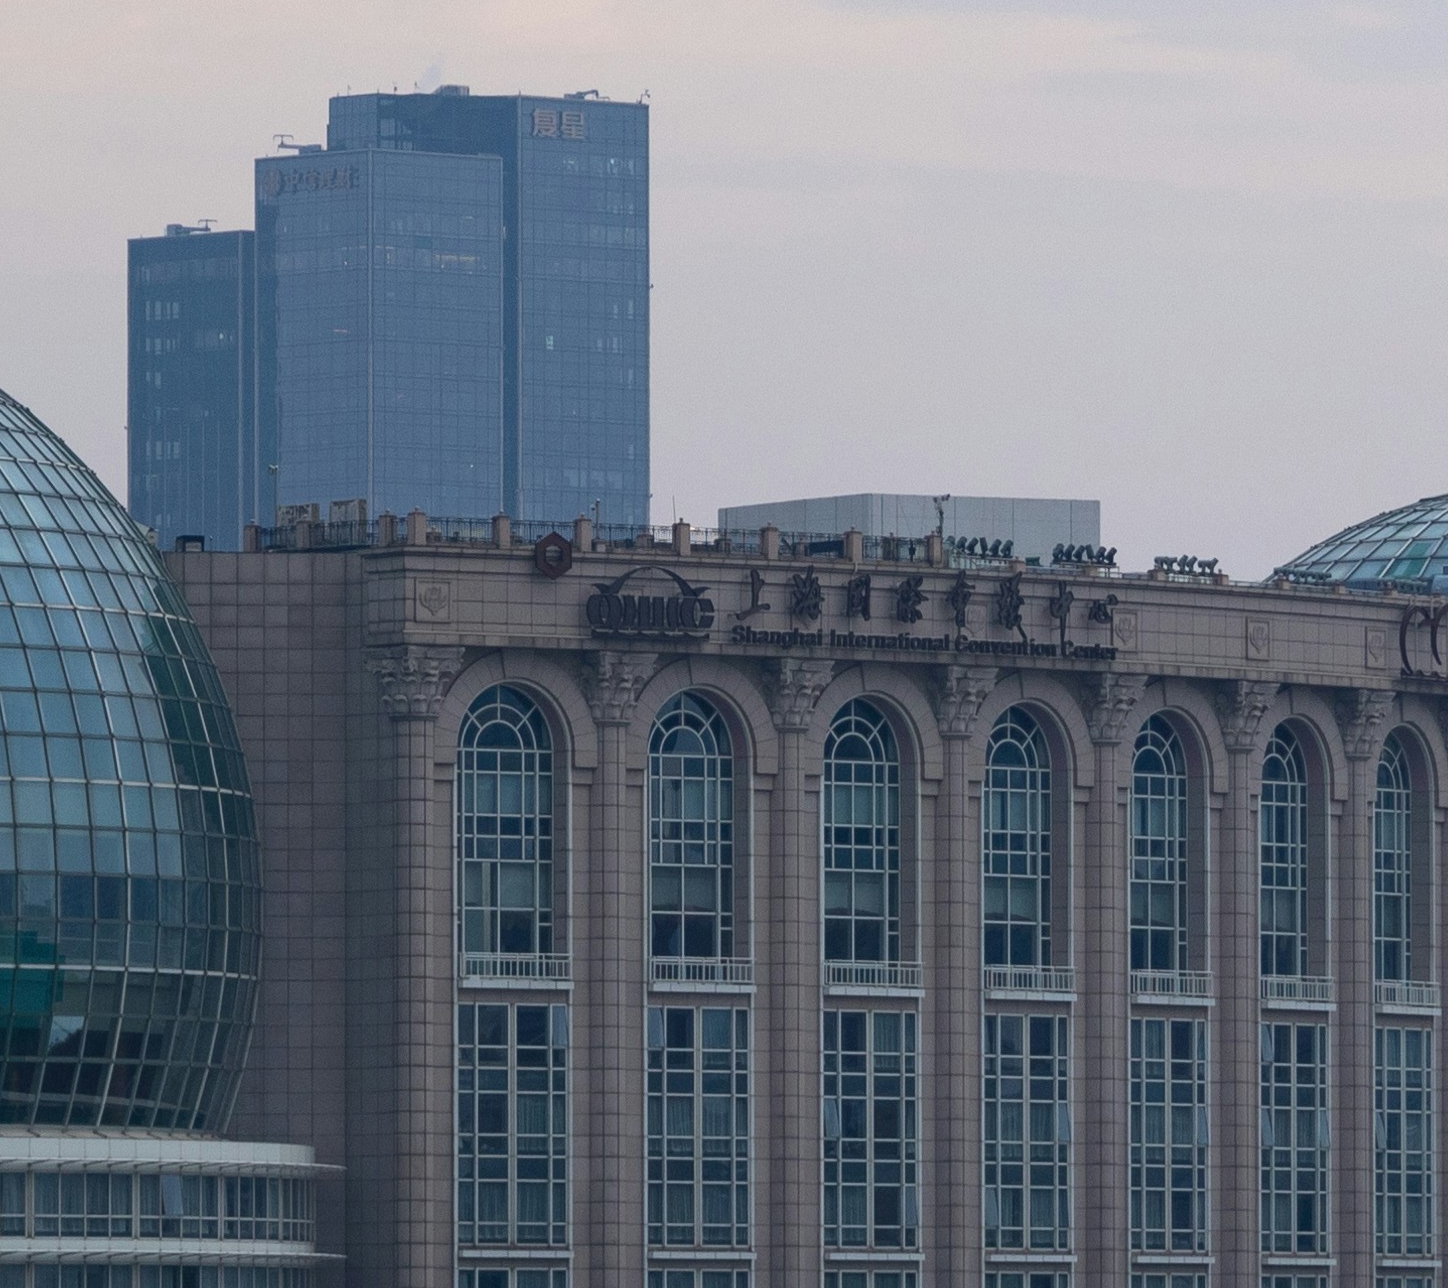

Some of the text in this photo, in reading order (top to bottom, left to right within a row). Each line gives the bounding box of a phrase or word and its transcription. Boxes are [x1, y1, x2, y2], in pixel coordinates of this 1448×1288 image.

[532, 107, 585, 140] 复星
[731, 624, 1119, 660] Shanghai International Convention Center
